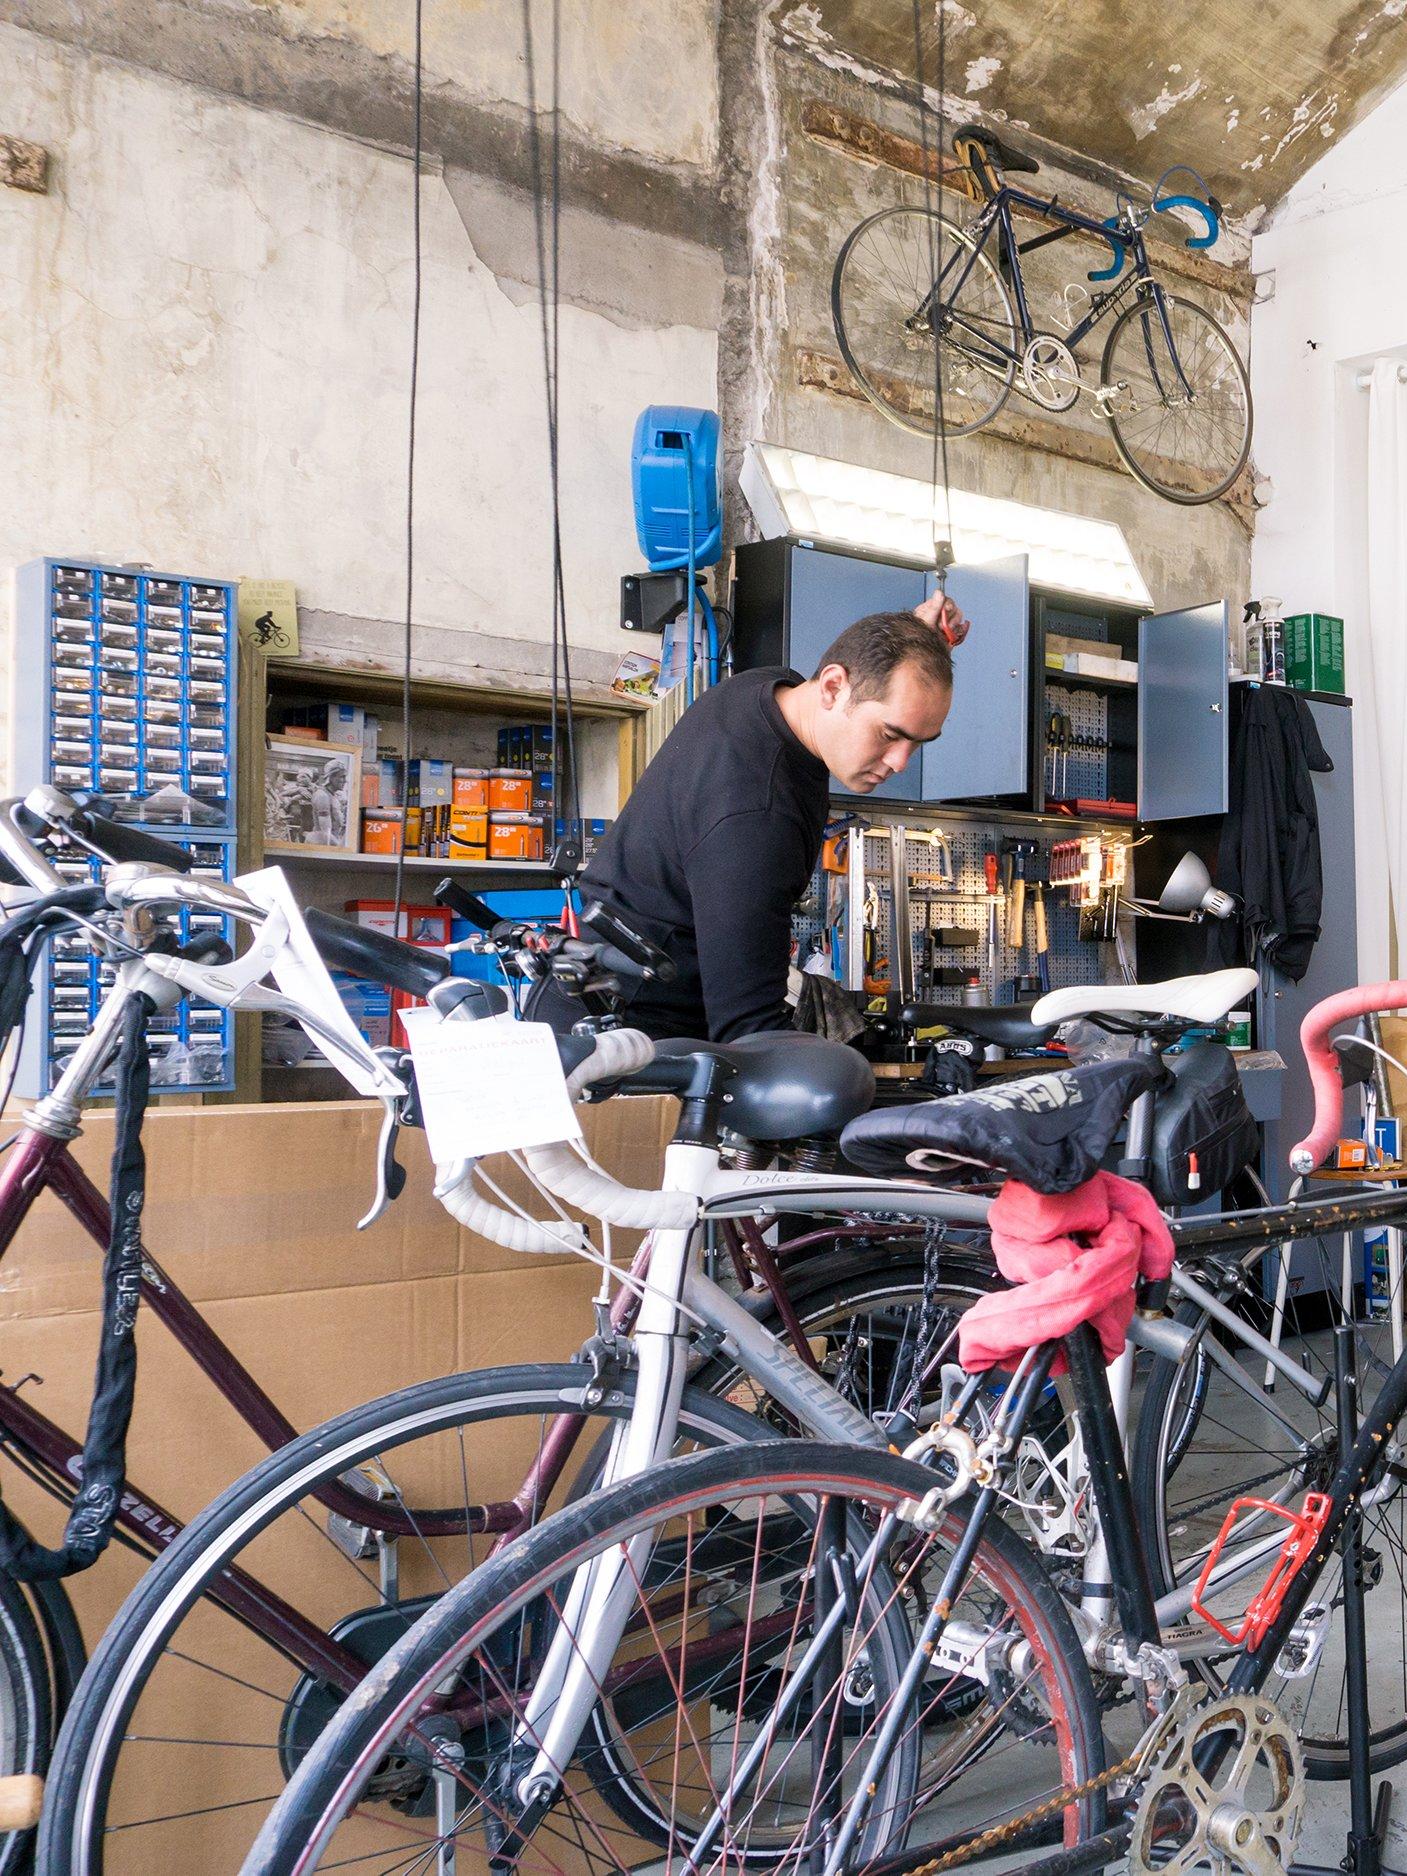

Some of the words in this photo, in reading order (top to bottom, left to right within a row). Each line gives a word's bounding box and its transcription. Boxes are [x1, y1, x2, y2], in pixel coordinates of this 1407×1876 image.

[939, 1043, 967, 1052] ABUS
[743, 1174, 795, 1187] Dolce
[1167, 1629, 1203, 1640] TIAGRA
